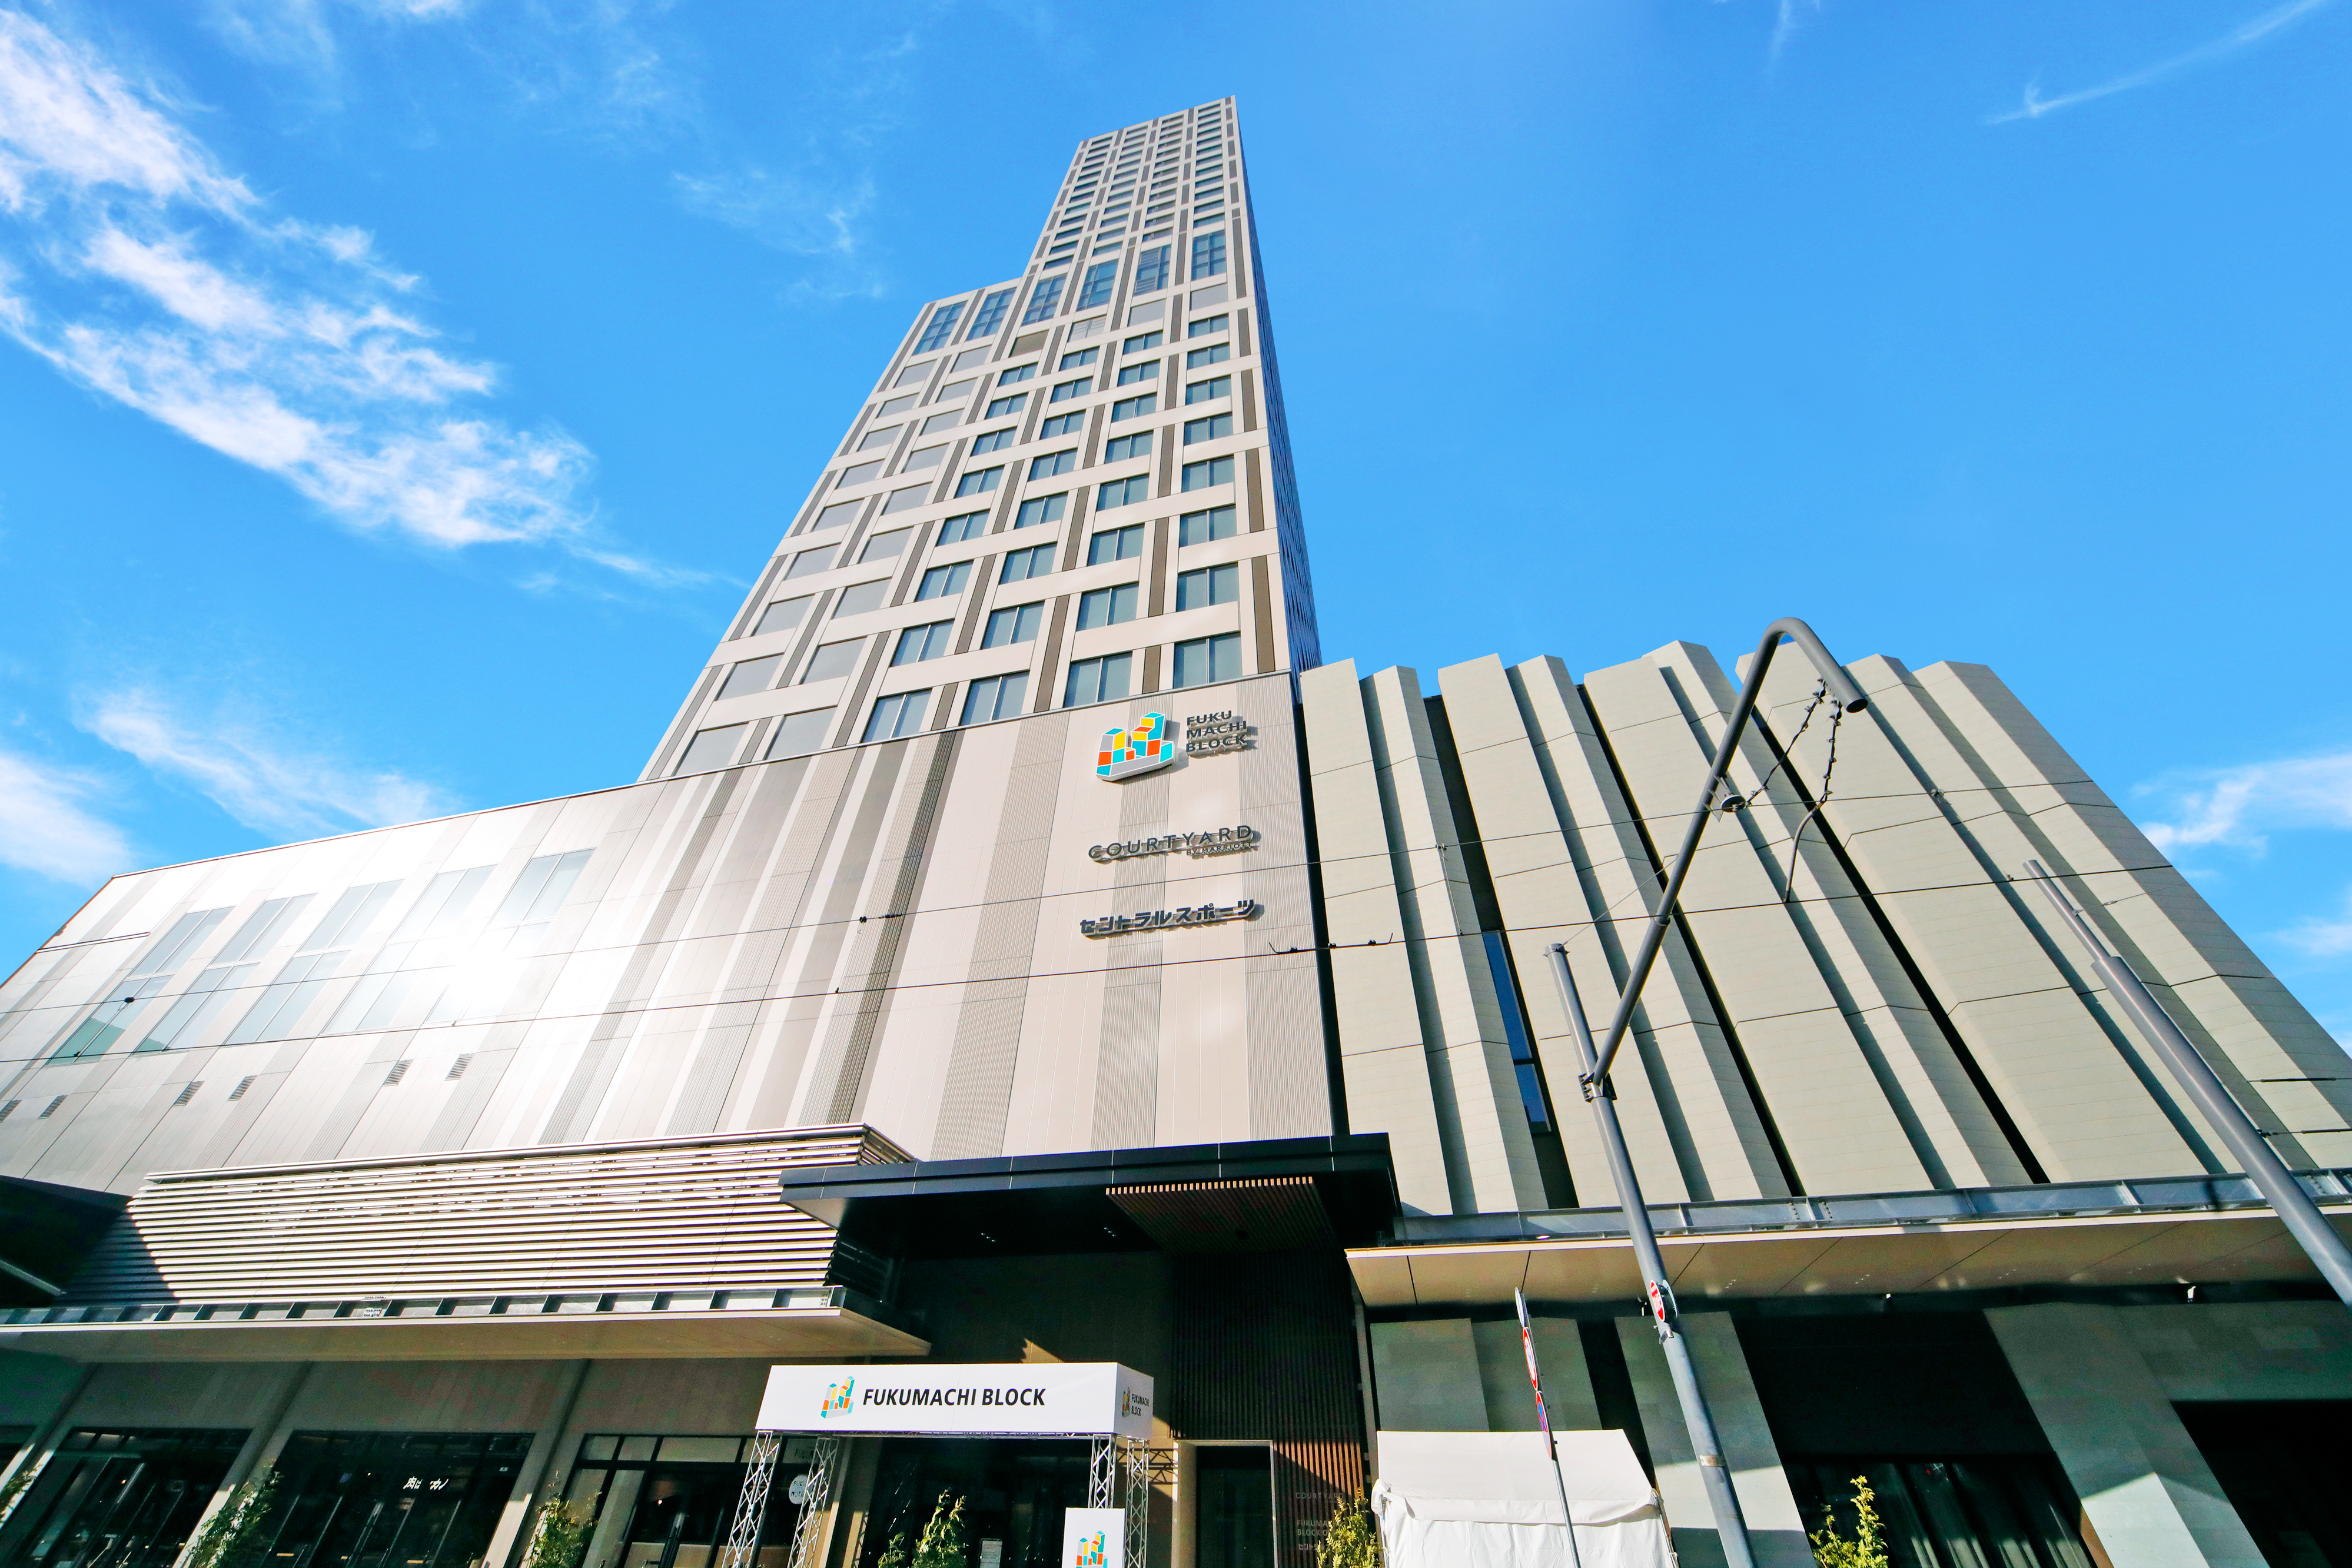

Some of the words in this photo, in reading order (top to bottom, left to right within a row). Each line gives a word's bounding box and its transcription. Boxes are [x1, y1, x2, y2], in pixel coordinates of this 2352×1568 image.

[1187, 710, 1232, 726] FUKU
[1187, 720, 1247, 739] MACHI
[1186, 734, 1248, 753] BLOCK
[1088, 825, 1251, 858] COURTYARD
[1202, 842, 1251, 853] MARRIOTT
[1079, 899, 1254, 934] セントラルスポーツ
[863, 1388, 976, 1406] FUKUMACHI
[982, 1388, 1047, 1406] BLOCK
